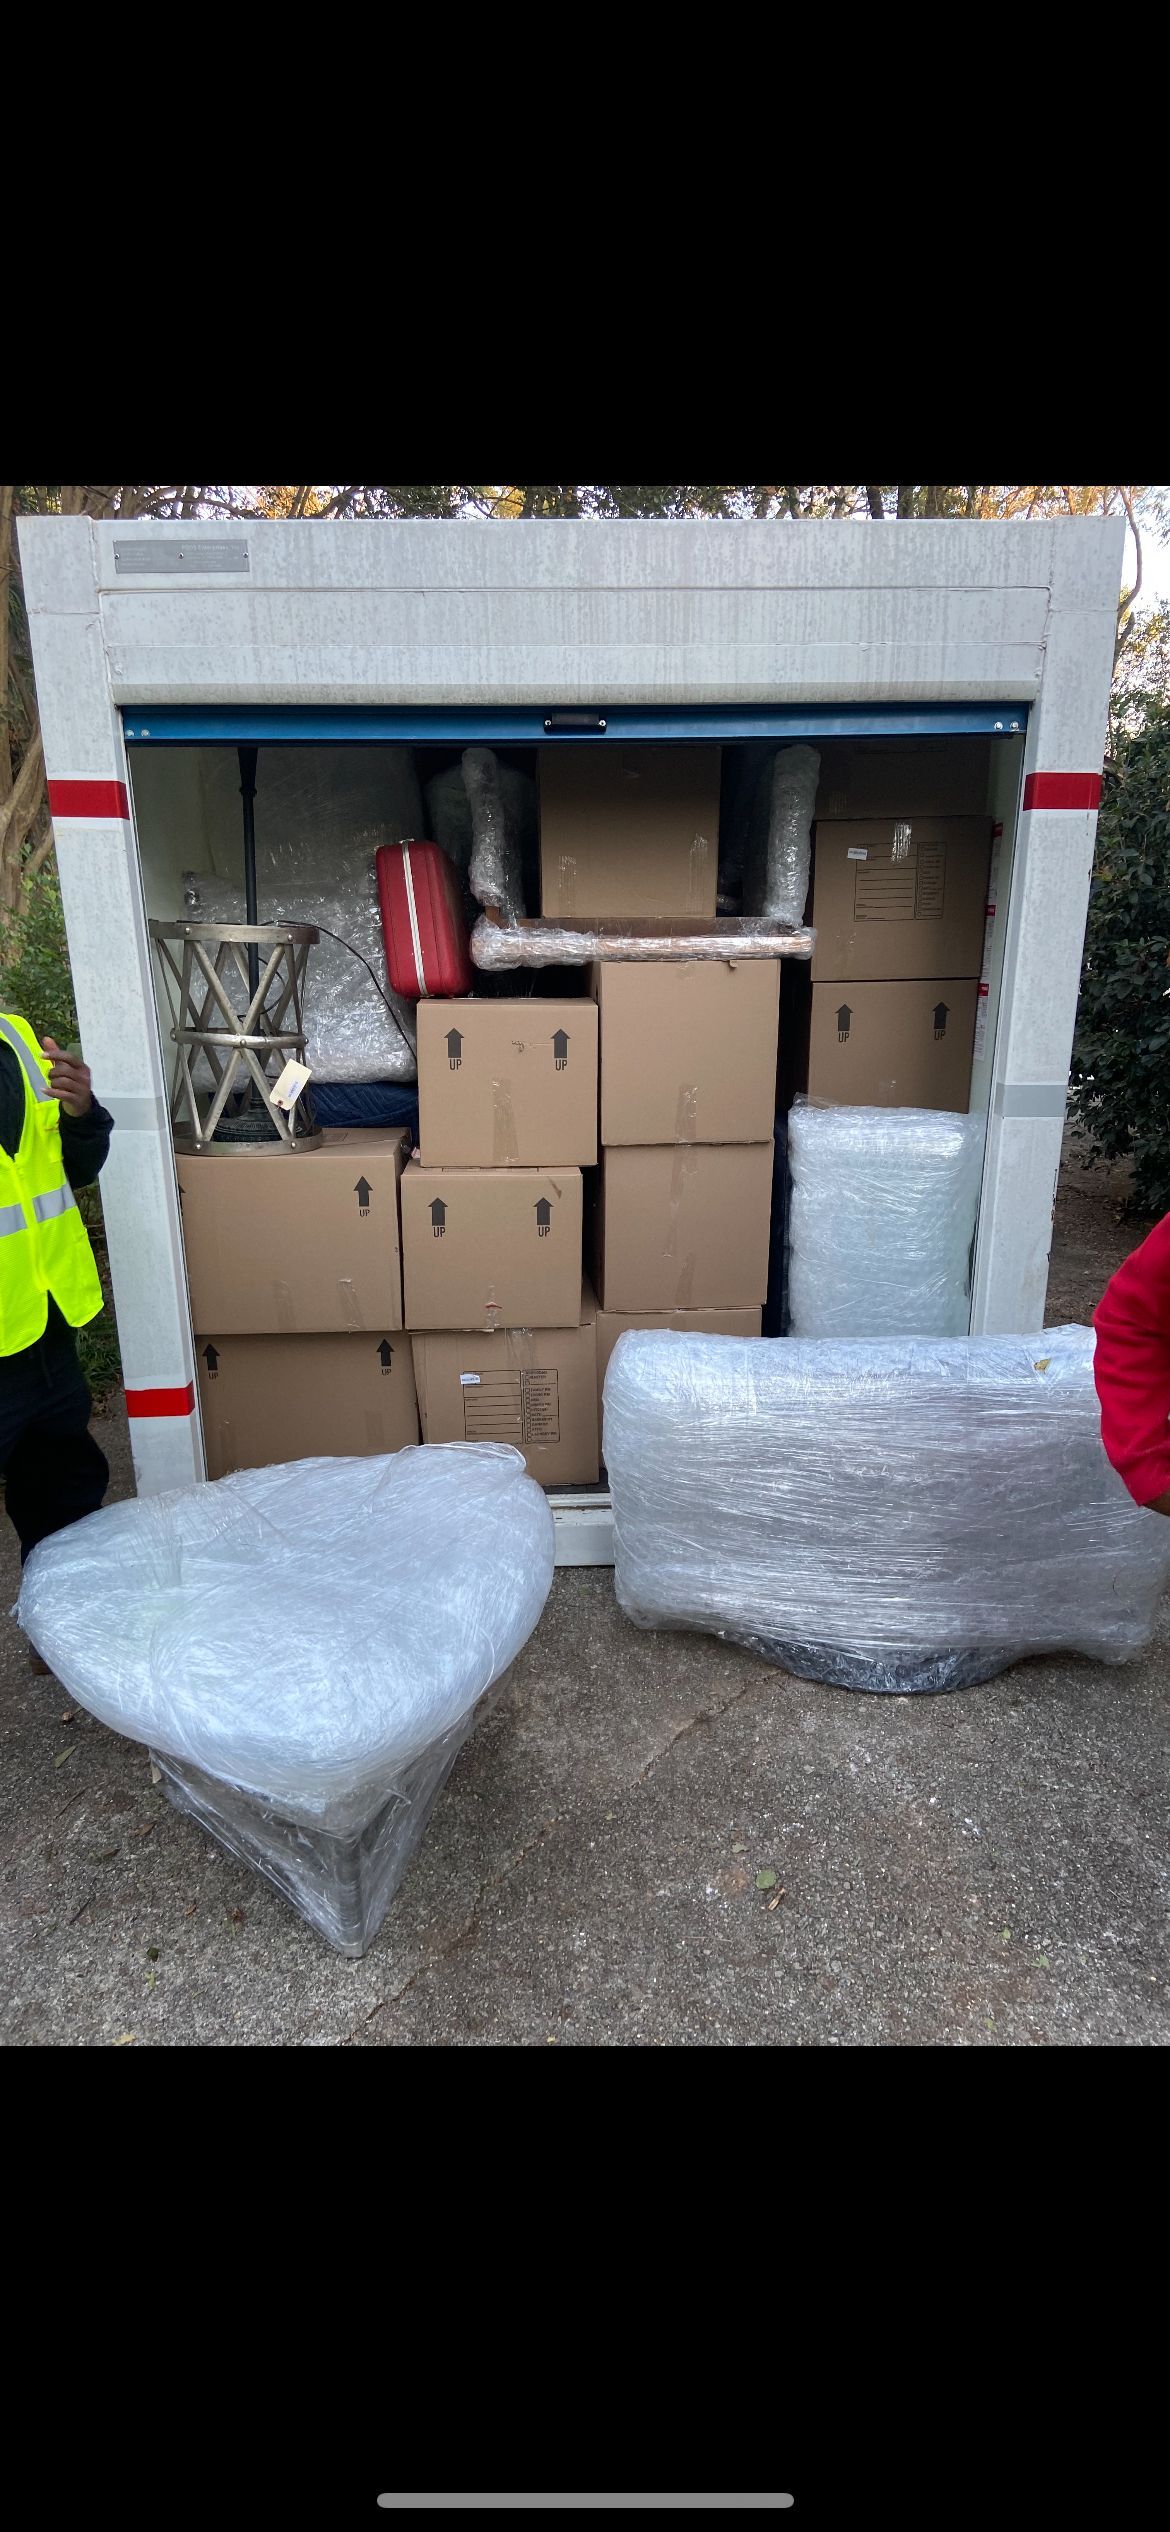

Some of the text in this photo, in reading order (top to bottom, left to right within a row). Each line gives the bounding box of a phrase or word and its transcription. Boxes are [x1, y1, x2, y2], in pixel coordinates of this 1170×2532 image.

[838, 1032, 850, 1043] UP
[934, 1030, 946, 1041] UP
[449, 1058, 462, 1071] UP
[555, 1059, 568, 1071] UP
[359, 1209, 371, 1217] UP
[433, 1226, 446, 1238] UP
[538, 1226, 551, 1238] UP
[208, 1372, 219, 1380] UP
[381, 1368, 392, 1376] UP
